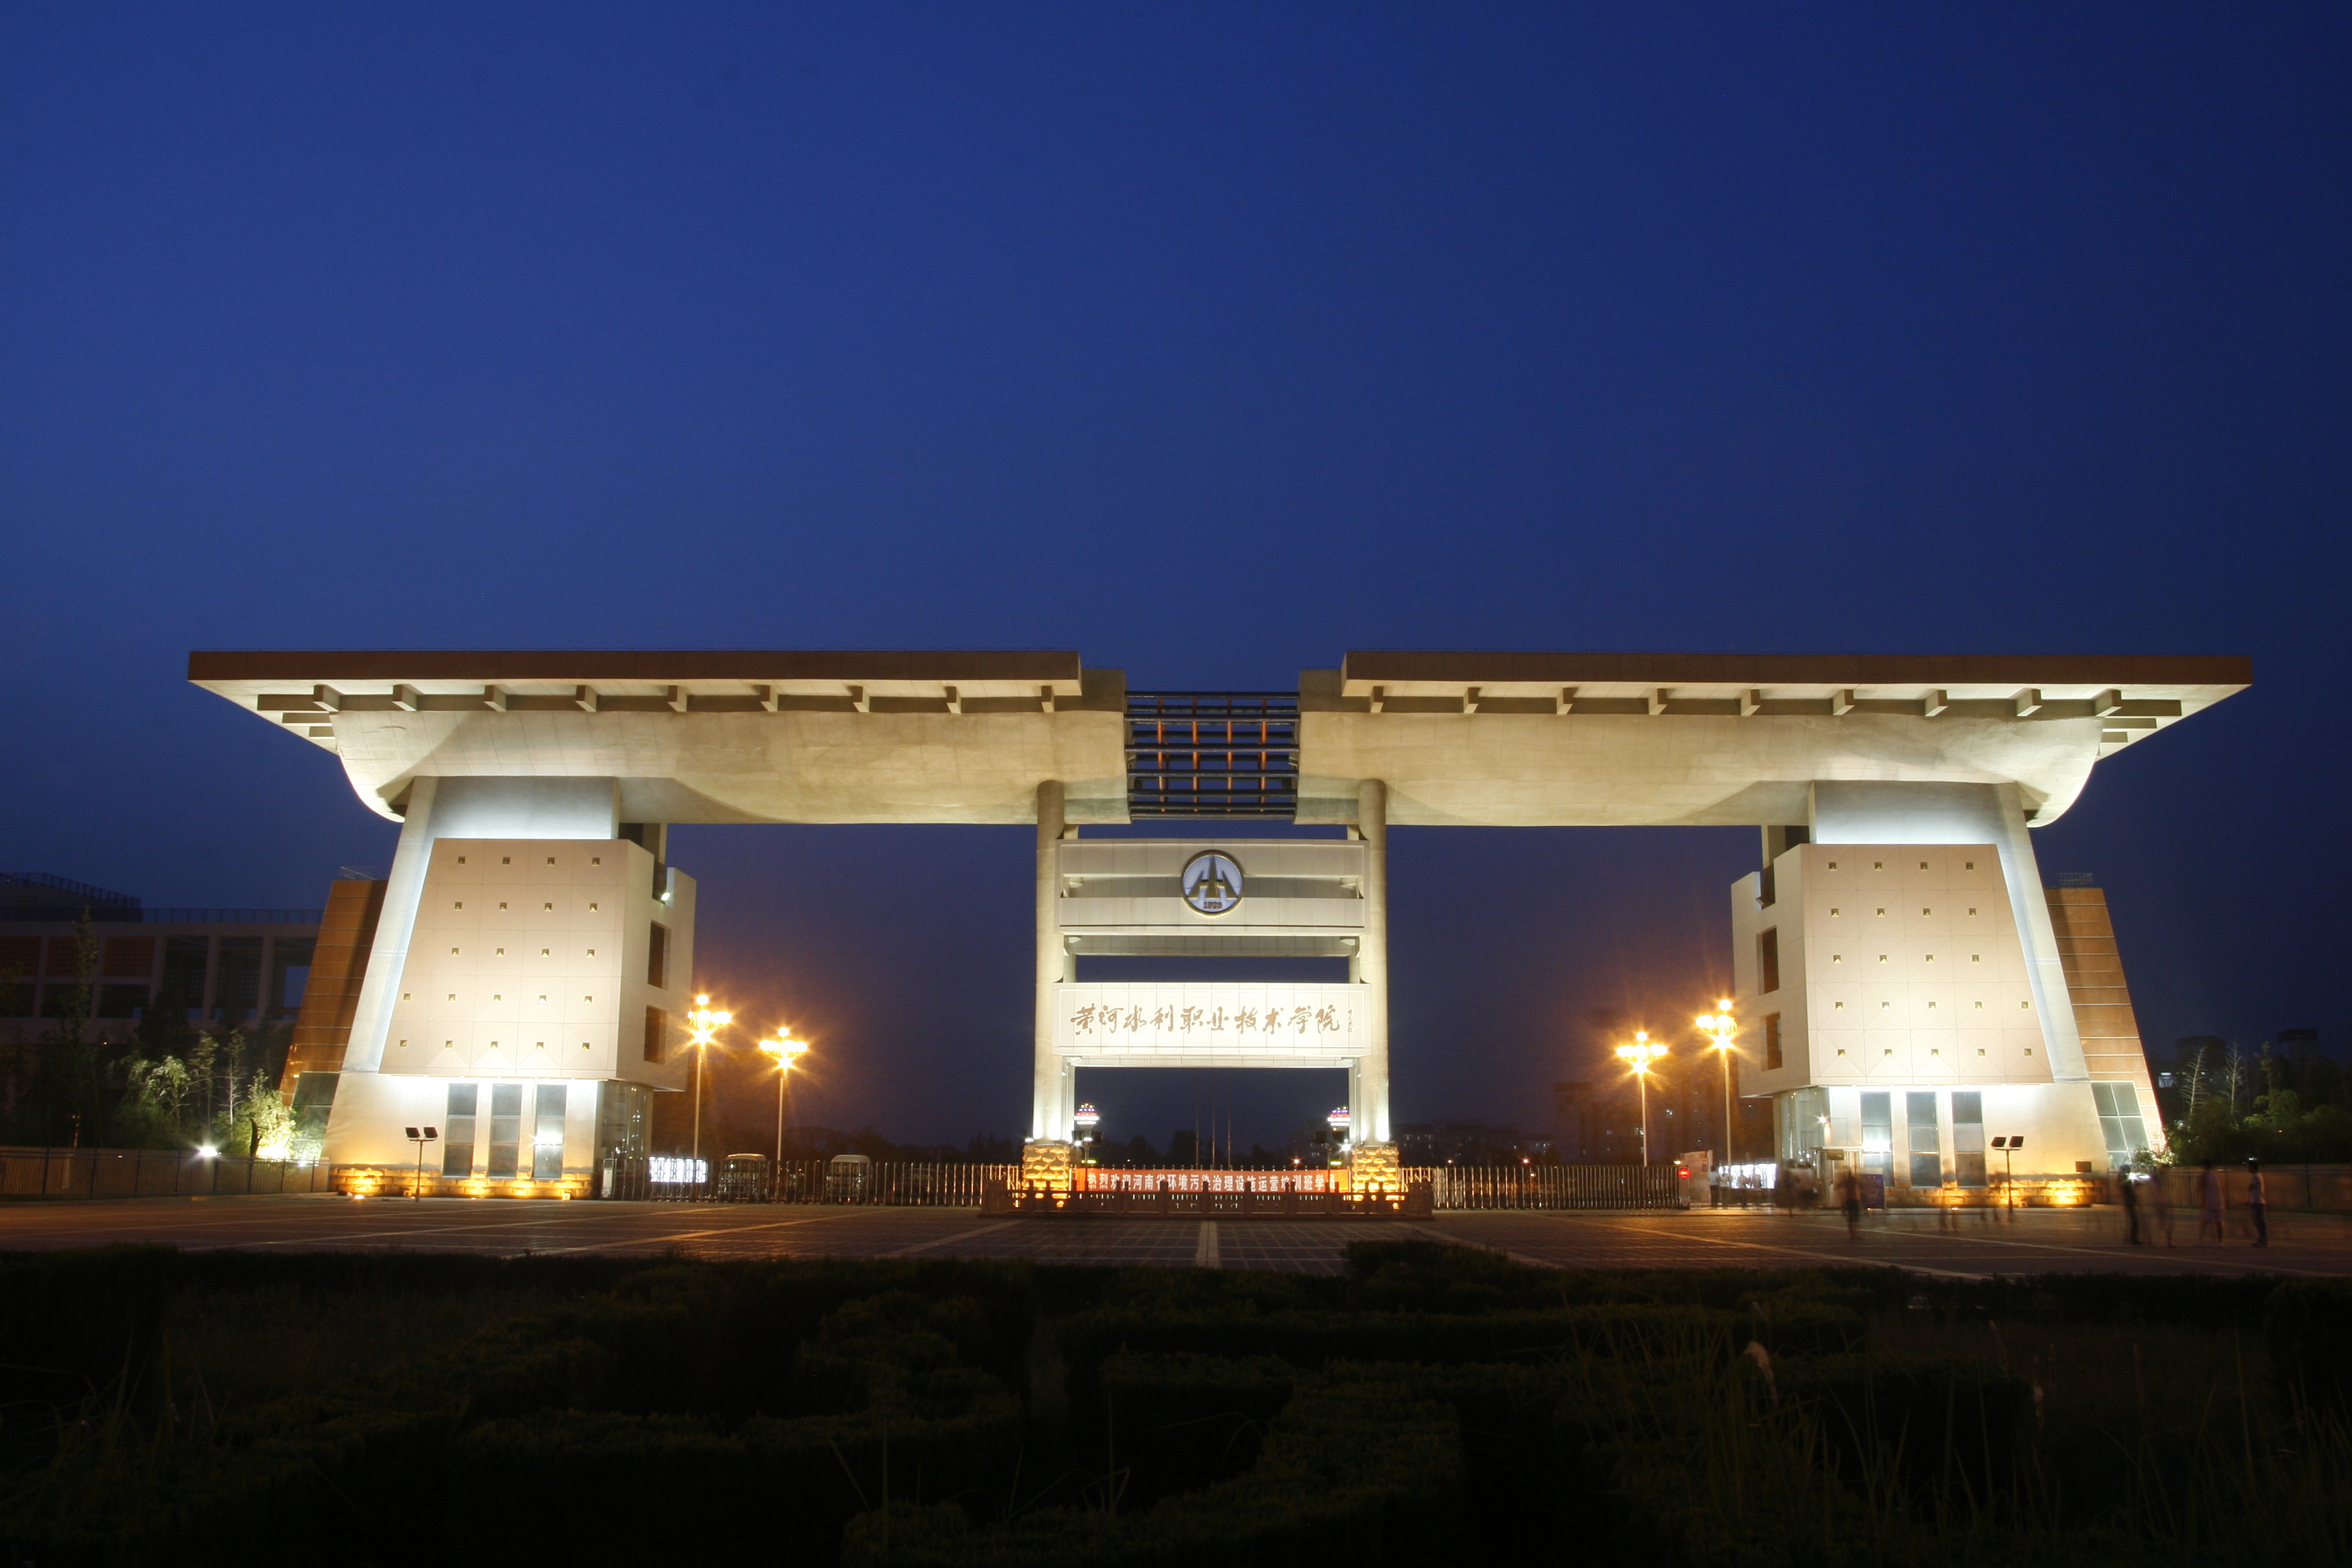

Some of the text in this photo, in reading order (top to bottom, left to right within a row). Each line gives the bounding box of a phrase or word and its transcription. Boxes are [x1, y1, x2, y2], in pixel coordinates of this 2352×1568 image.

[1070, 1003, 1340, 1035] 黄河水利职业技术学院
